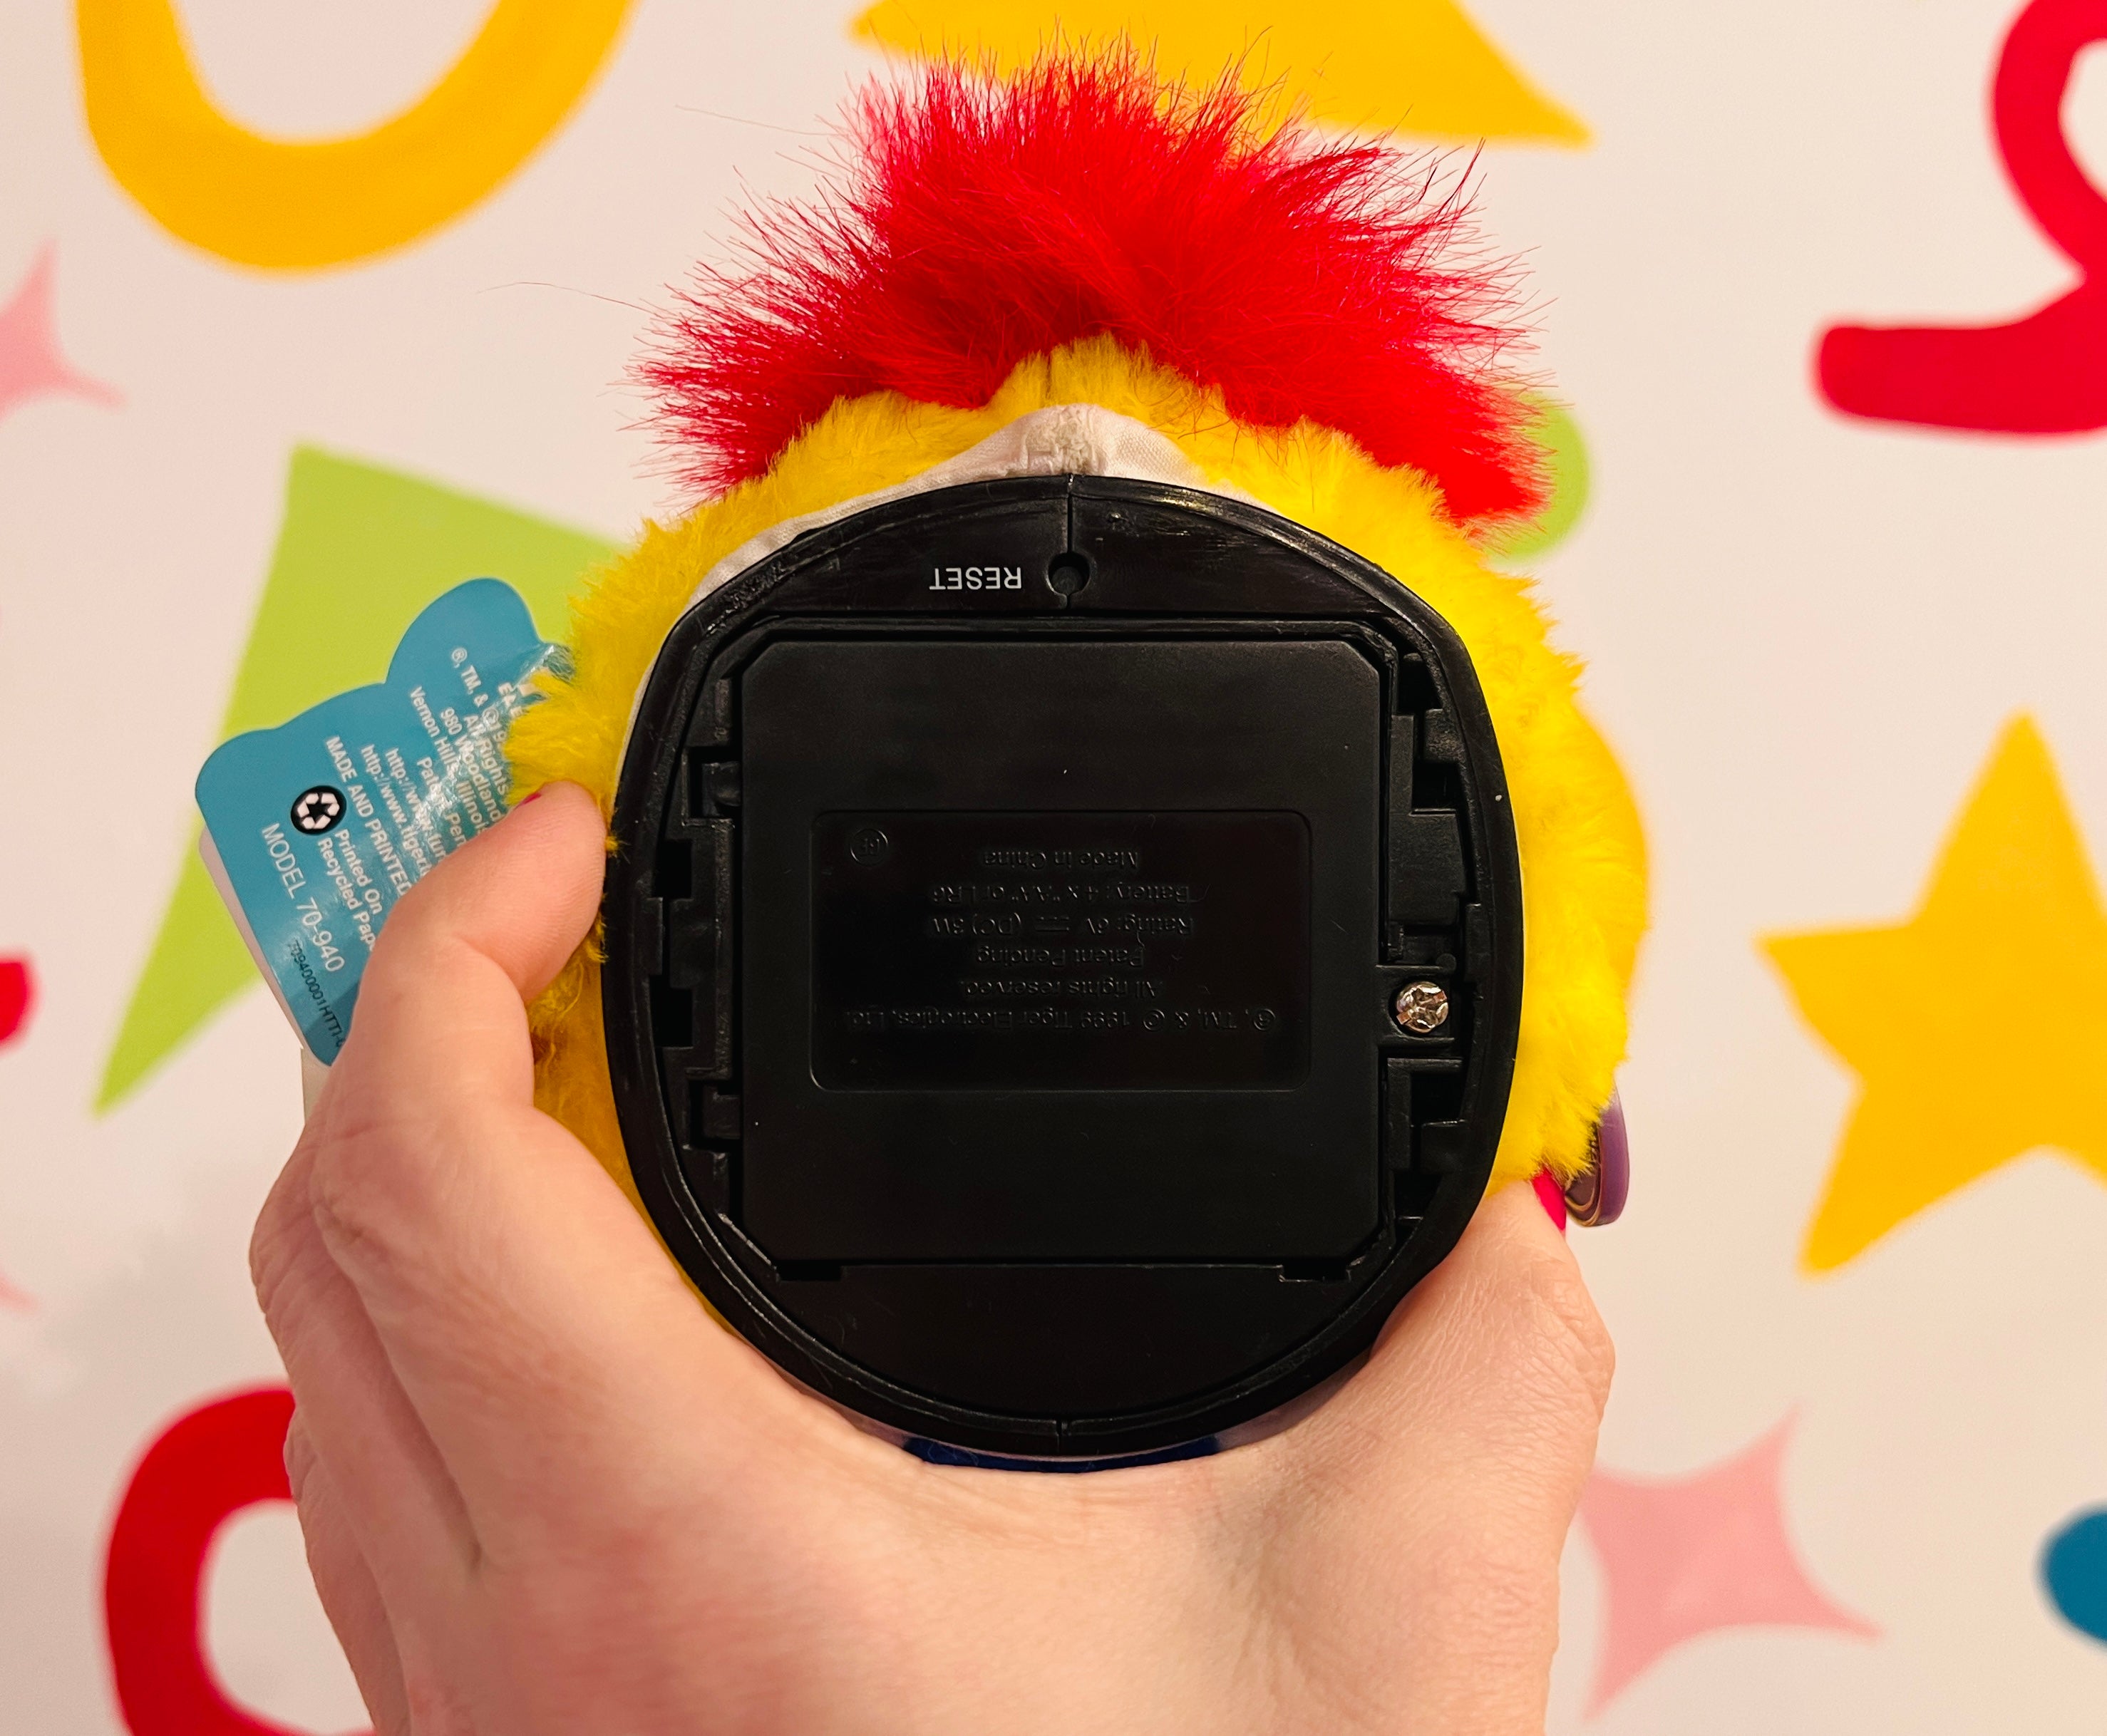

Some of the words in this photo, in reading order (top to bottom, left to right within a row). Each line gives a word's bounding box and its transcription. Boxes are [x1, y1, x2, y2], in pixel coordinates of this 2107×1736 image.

[929, 567, 1023, 589] RESET
[458, 665, 484, 695] TM,
[408, 686, 441, 737] Vernon
[472, 693, 490, 707] &
[463, 712, 487, 738] All
[478, 704, 512, 748] ©19
[438, 706, 463, 735] 980
[453, 735, 505, 822] Woodland
[474, 738, 512, 795] Rights
[416, 756, 455, 813] Patent
[325, 735, 357, 782] MADE
[347, 782, 375, 819] AND
[364, 818, 413, 896] PRINTED
[334, 829, 371, 887] Printed
[362, 886, 385, 914] On
[982, 850, 1048, 871] China
[1051, 850, 1073, 870] in
[1078, 850, 1141, 870] Made
[316, 837, 363, 910] Recycled
[260, 822, 309, 899] MODEL
[294, 897, 346, 973] 70-940
[928, 885, 978, 906] LR6
[983, 885, 1006, 901] or
[1083, 884, 1098, 902] 4
[1104, 880, 1190, 905] Battery:
[971, 911, 1022, 938] (DC)
[1114, 911, 1194, 937] Rating:
[975, 945, 1067, 969] Pending
[1072, 948, 1144, 969] Patent
[958, 980, 1061, 999] reserved.
[1067, 976, 1128, 999] rights
[1134, 980, 1163, 999] All
[1019, 1005, 1073, 1030] Tiger
[1079, 1011, 1129, 1030] 1999
[1175, 1009, 1192, 1030] &
[1197, 1008, 1239, 1030] TM,
